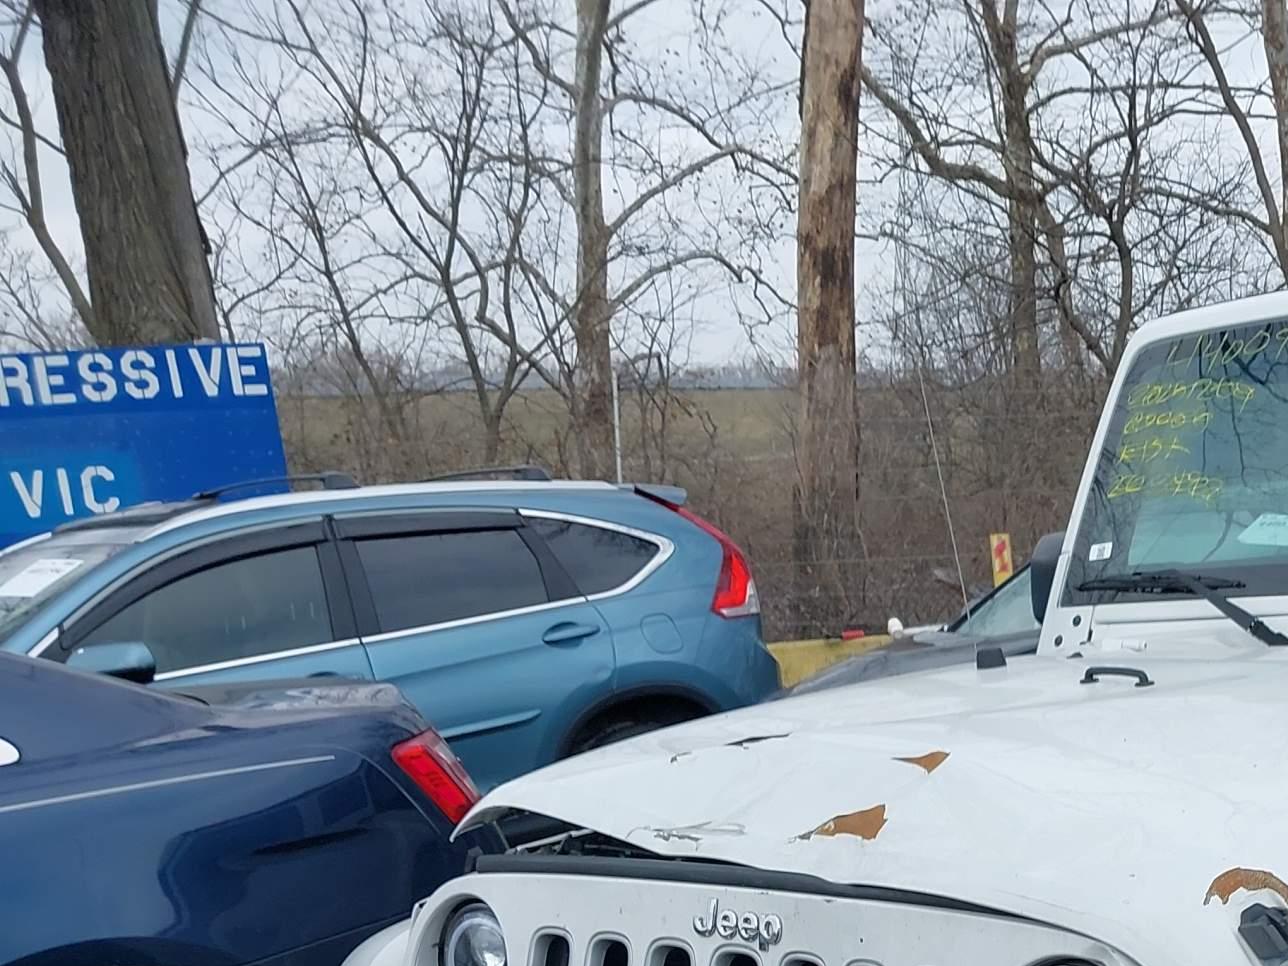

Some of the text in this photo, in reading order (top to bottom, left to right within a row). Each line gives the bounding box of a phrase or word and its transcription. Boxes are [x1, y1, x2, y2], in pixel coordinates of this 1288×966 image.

[0, 347, 268, 407] RESSIVE
[10, 465, 121, 519] VIC
[693, 898, 782, 952] Jeep
